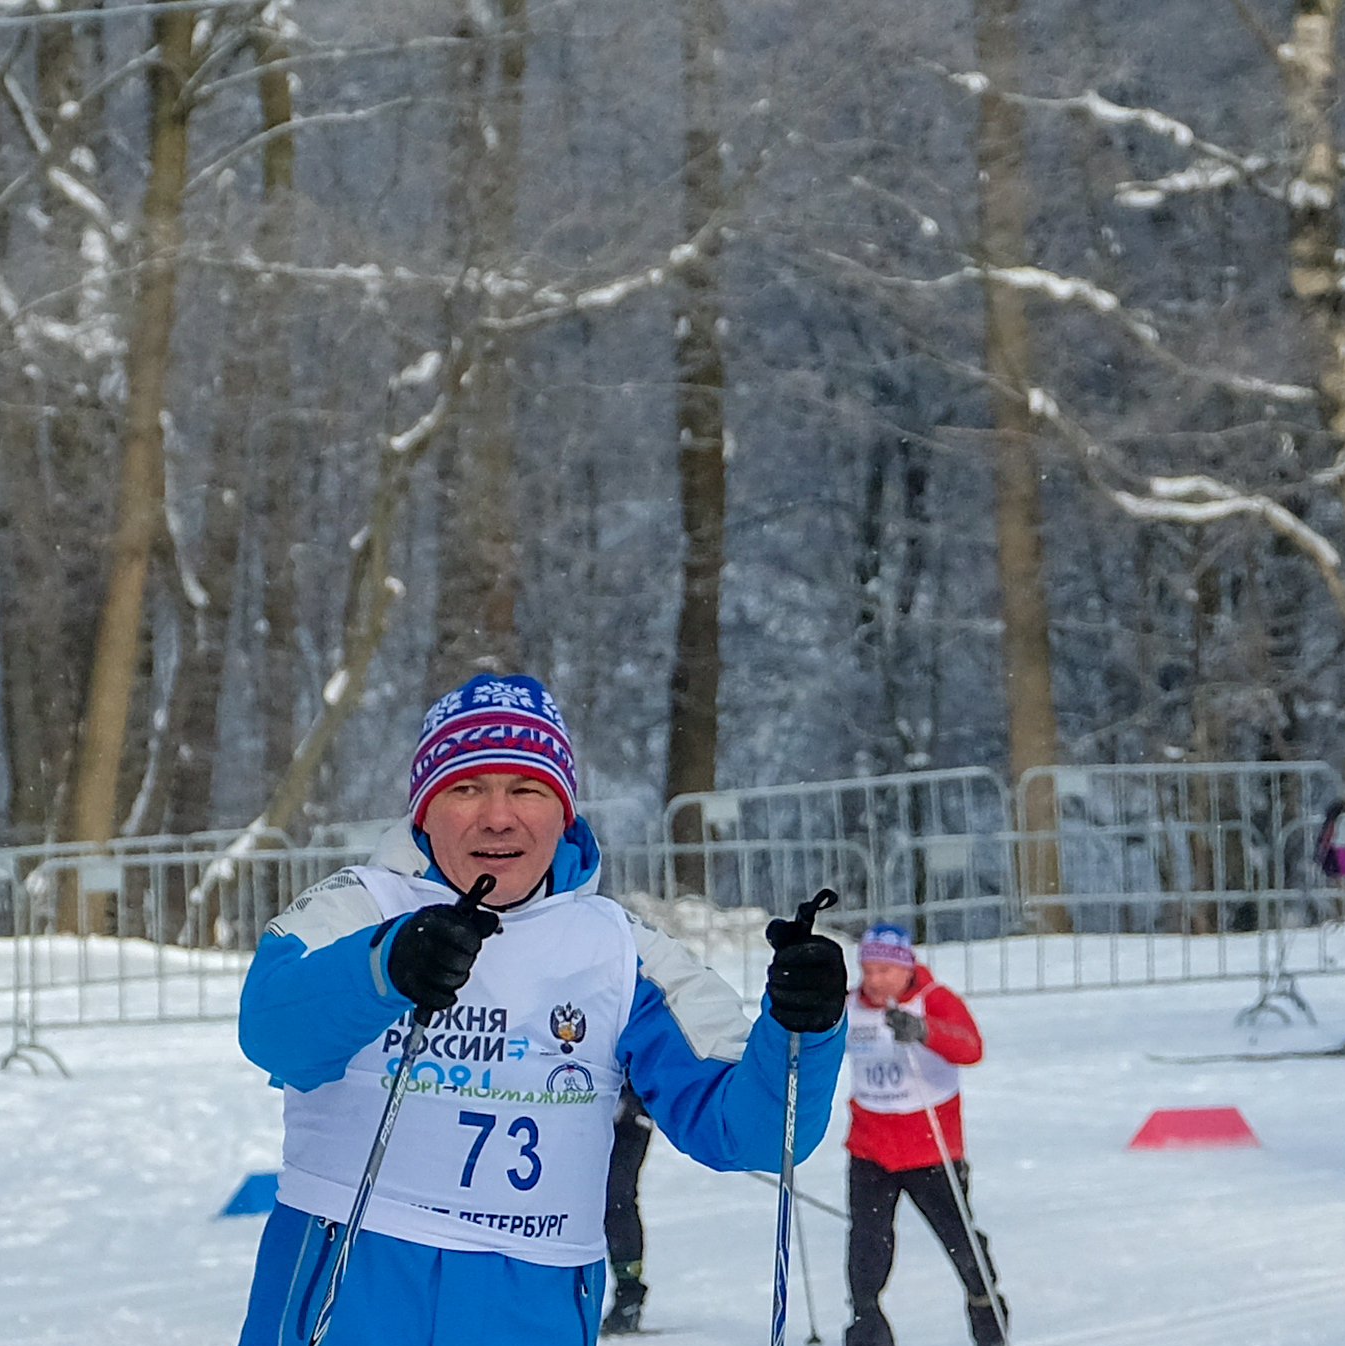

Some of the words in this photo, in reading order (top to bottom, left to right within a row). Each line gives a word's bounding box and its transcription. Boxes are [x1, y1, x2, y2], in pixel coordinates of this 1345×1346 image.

[382, 1029, 506, 1062] РОССИИ
[398, 1006, 507, 1033] ЖНЯ
[380, 1066, 410, 1147] FISCHER
[381, 1075, 440, 1096] СОРТ
[785, 1073, 798, 1154] FISCHER
[458, 1111, 542, 1191] 73
